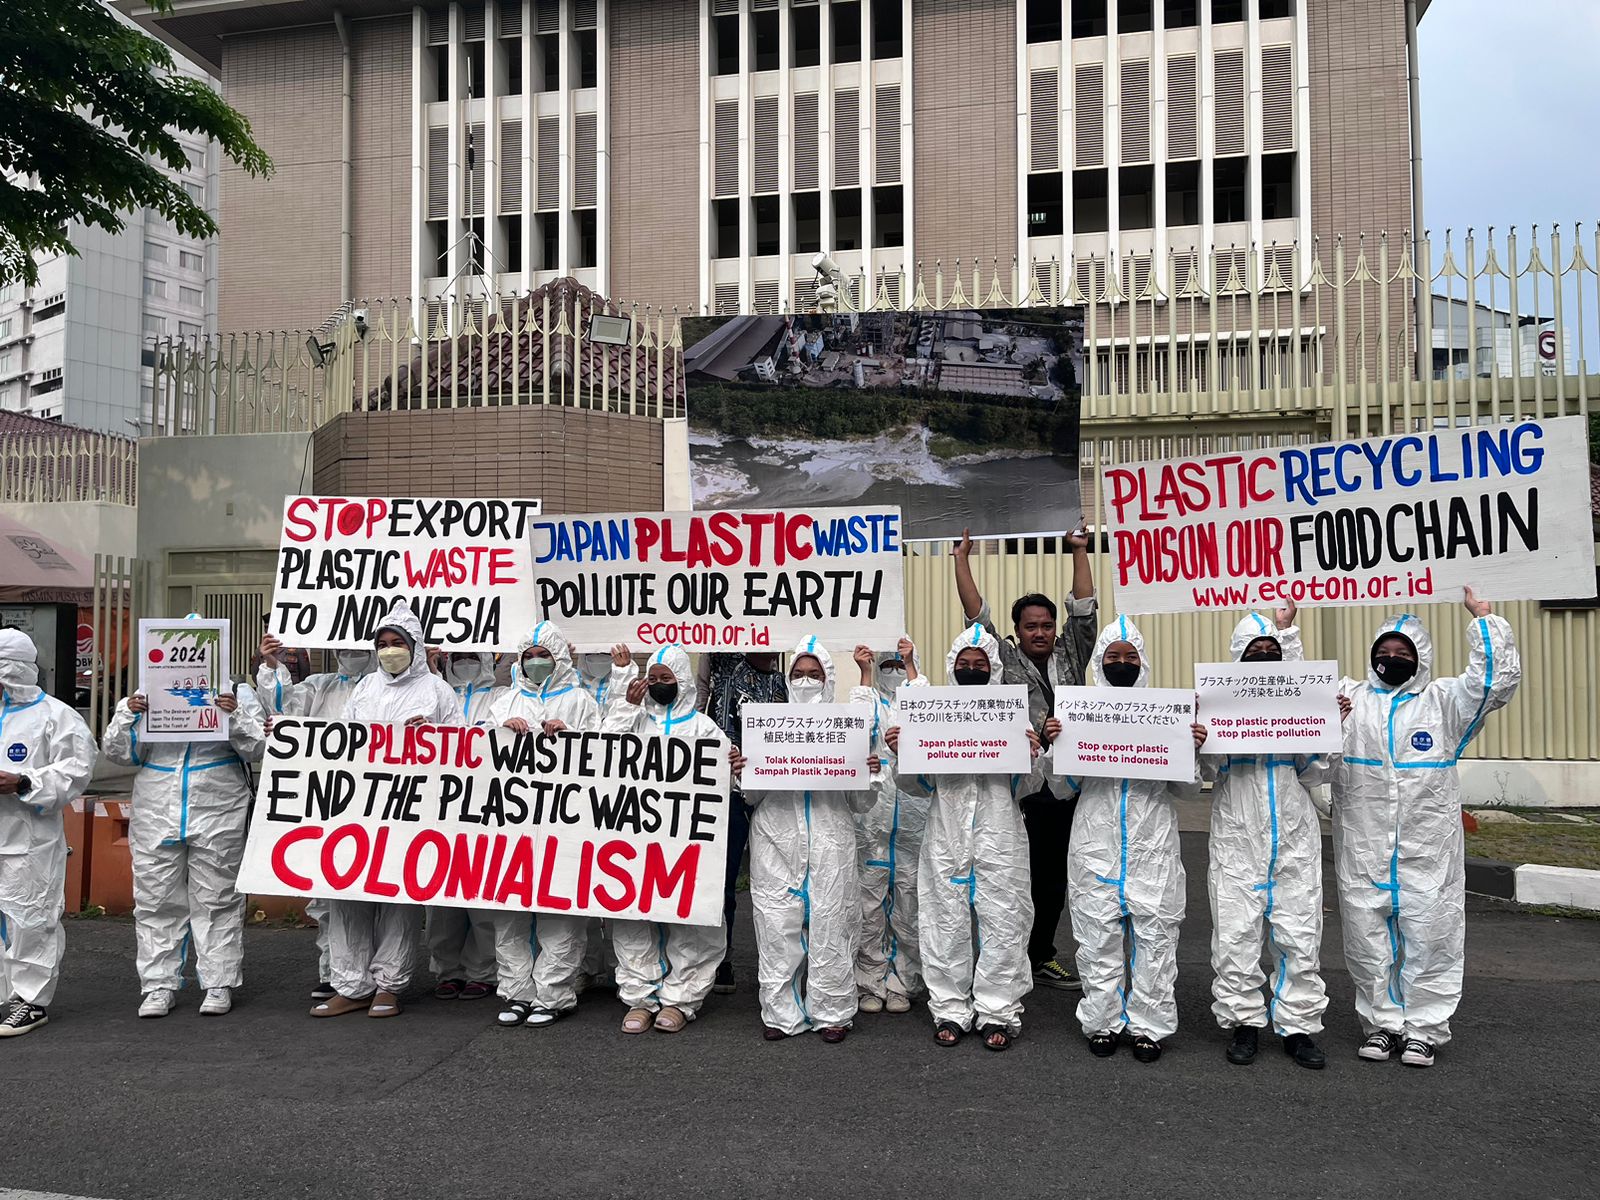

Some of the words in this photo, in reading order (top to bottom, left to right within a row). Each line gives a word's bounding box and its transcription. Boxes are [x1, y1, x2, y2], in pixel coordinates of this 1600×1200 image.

[1105, 456, 1277, 524] PLASTIC
[1279, 422, 1545, 506] RECYCLING
[286, 498, 387, 542] STOP
[388, 499, 538, 540] EXPORT
[533, 519, 630, 563] JAPAN
[634, 511, 814, 568] PLASTIC
[812, 514, 900, 557] WASTE
[1114, 521, 1220, 586] POISON
[1227, 517, 1284, 578] OUR
[281, 547, 400, 590] PLASTIC
[405, 547, 519, 589] WASTE
[1193, 567, 1433, 606] www.ecoton.or.id
[536, 572, 657, 620] POLLUTE
[667, 572, 732, 620] OUR
[743, 569, 883, 620] EARTH
[276, 602, 317, 634] TO
[327, 594, 500, 645] INDNESIA
[637, 621, 770, 646] ecoton.or.id
[170, 647, 206, 663] 2024
[1233, 688, 1302, 698] ック汚染を止める
[900, 699, 1025, 710] 日本のプラスチック廃棄物が私
[198, 709, 219, 729] ASIA
[746, 717, 865, 730] 日本のプラスチック廃棄物
[909, 712, 1016, 723] たちの川を汚染しています
[1068, 712, 1180, 726] 物の輸出を停止してください
[1211, 718, 1234, 727] Stop
[1236, 717, 1269, 727] plastic
[1271, 716, 1326, 727] production
[764, 731, 847, 744] 植民地主義を拒否
[1217, 729, 1239, 739] stop
[1241, 729, 1274, 739] plastic
[1277, 728, 1321, 738] pollution
[267, 720, 368, 762] STOP
[368, 724, 485, 769] PLASTIC
[919, 740, 946, 749] Japan
[948, 739, 978, 748] plastic
[1078, 742, 1100, 752] Stop
[1103, 744, 1134, 752] export
[1137, 744, 1169, 754] plastic
[765, 756, 788, 764] Tolak
[790, 756, 845, 765] Kolonialisasi
[928, 751, 959, 760] pollute
[979, 751, 1000, 759] river
[1078, 754, 1106, 763] waste
[1109, 755, 1119, 763] to
[1121, 755, 1169, 765] indonesia
[755, 767, 789, 777] Sampah
[792, 768, 822, 776] Plastik
[824, 768, 857, 777] Jepang
[267, 769, 356, 823] END
[363, 772, 428, 822] THE
[439, 774, 581, 827] PLASTIC
[589, 784, 723, 842] WASTE
[271, 823, 701, 919] COLONIALISM
